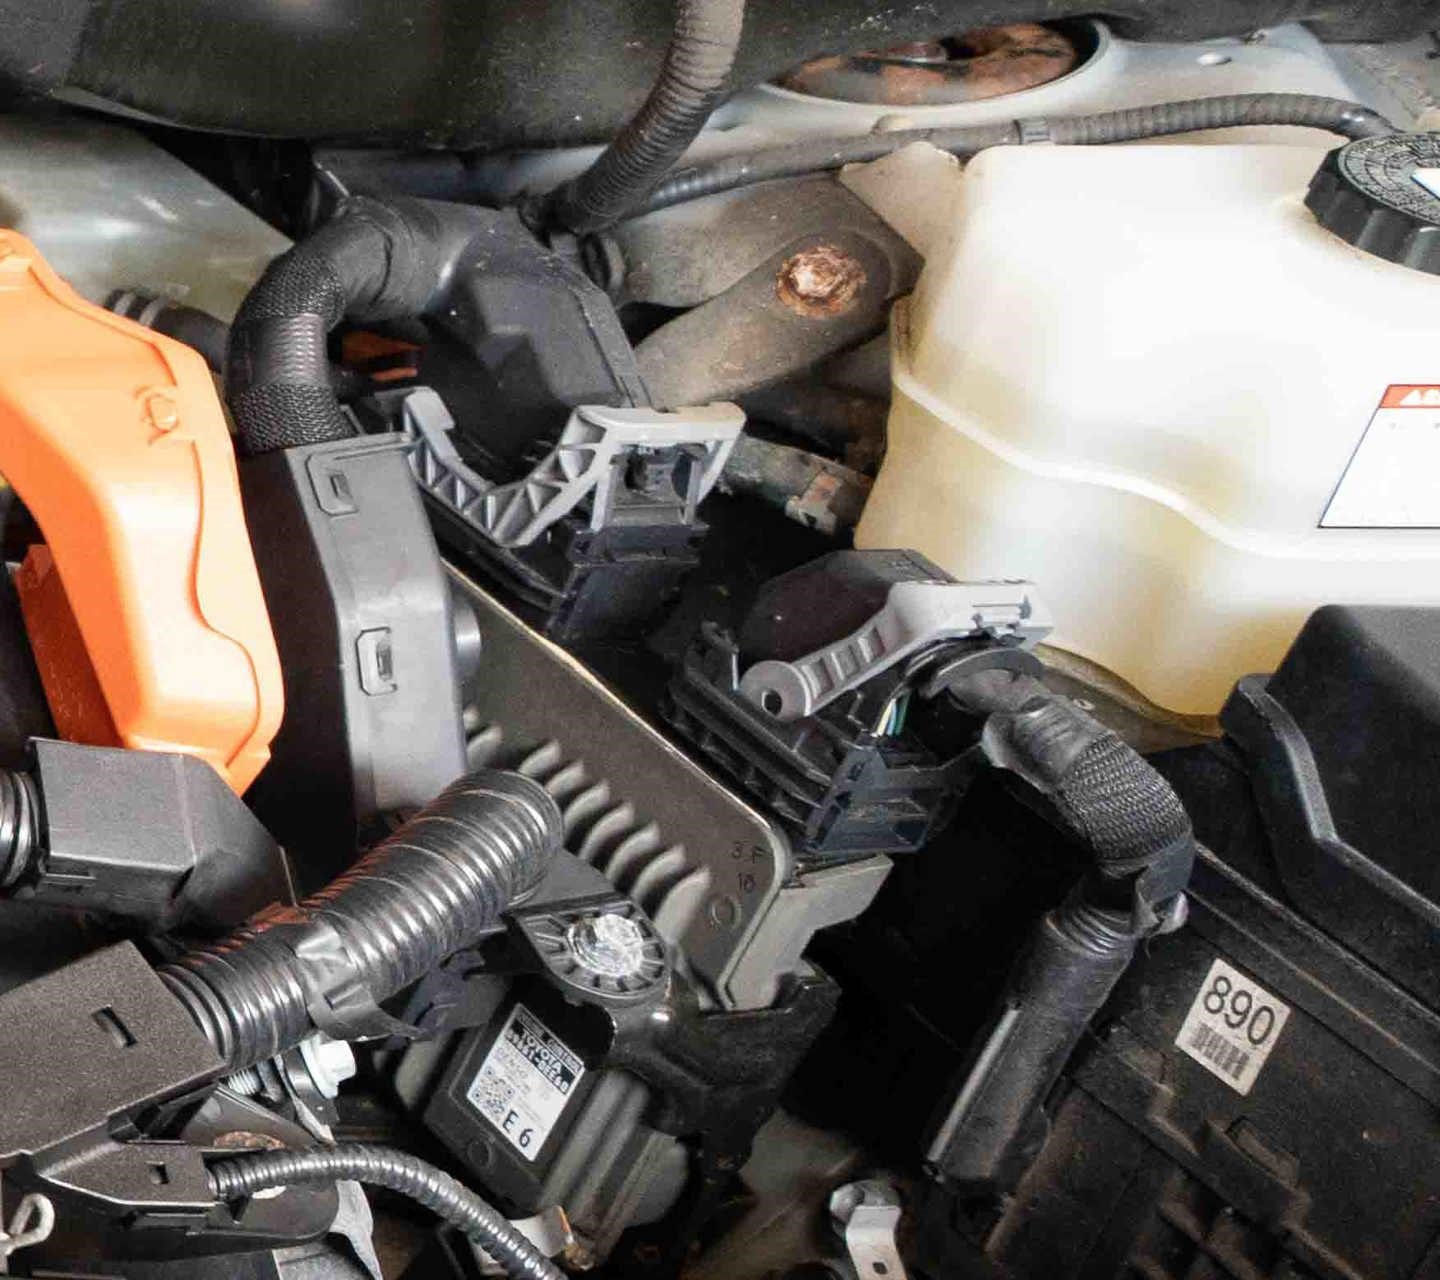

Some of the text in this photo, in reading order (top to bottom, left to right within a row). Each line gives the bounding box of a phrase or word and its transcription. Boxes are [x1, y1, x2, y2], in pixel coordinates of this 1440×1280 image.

[1204, 975, 1275, 1046] 890
[518, 1027, 564, 1075] TOYOTA
[501, 1109, 520, 1134] E
[518, 1127, 535, 1149] 6
